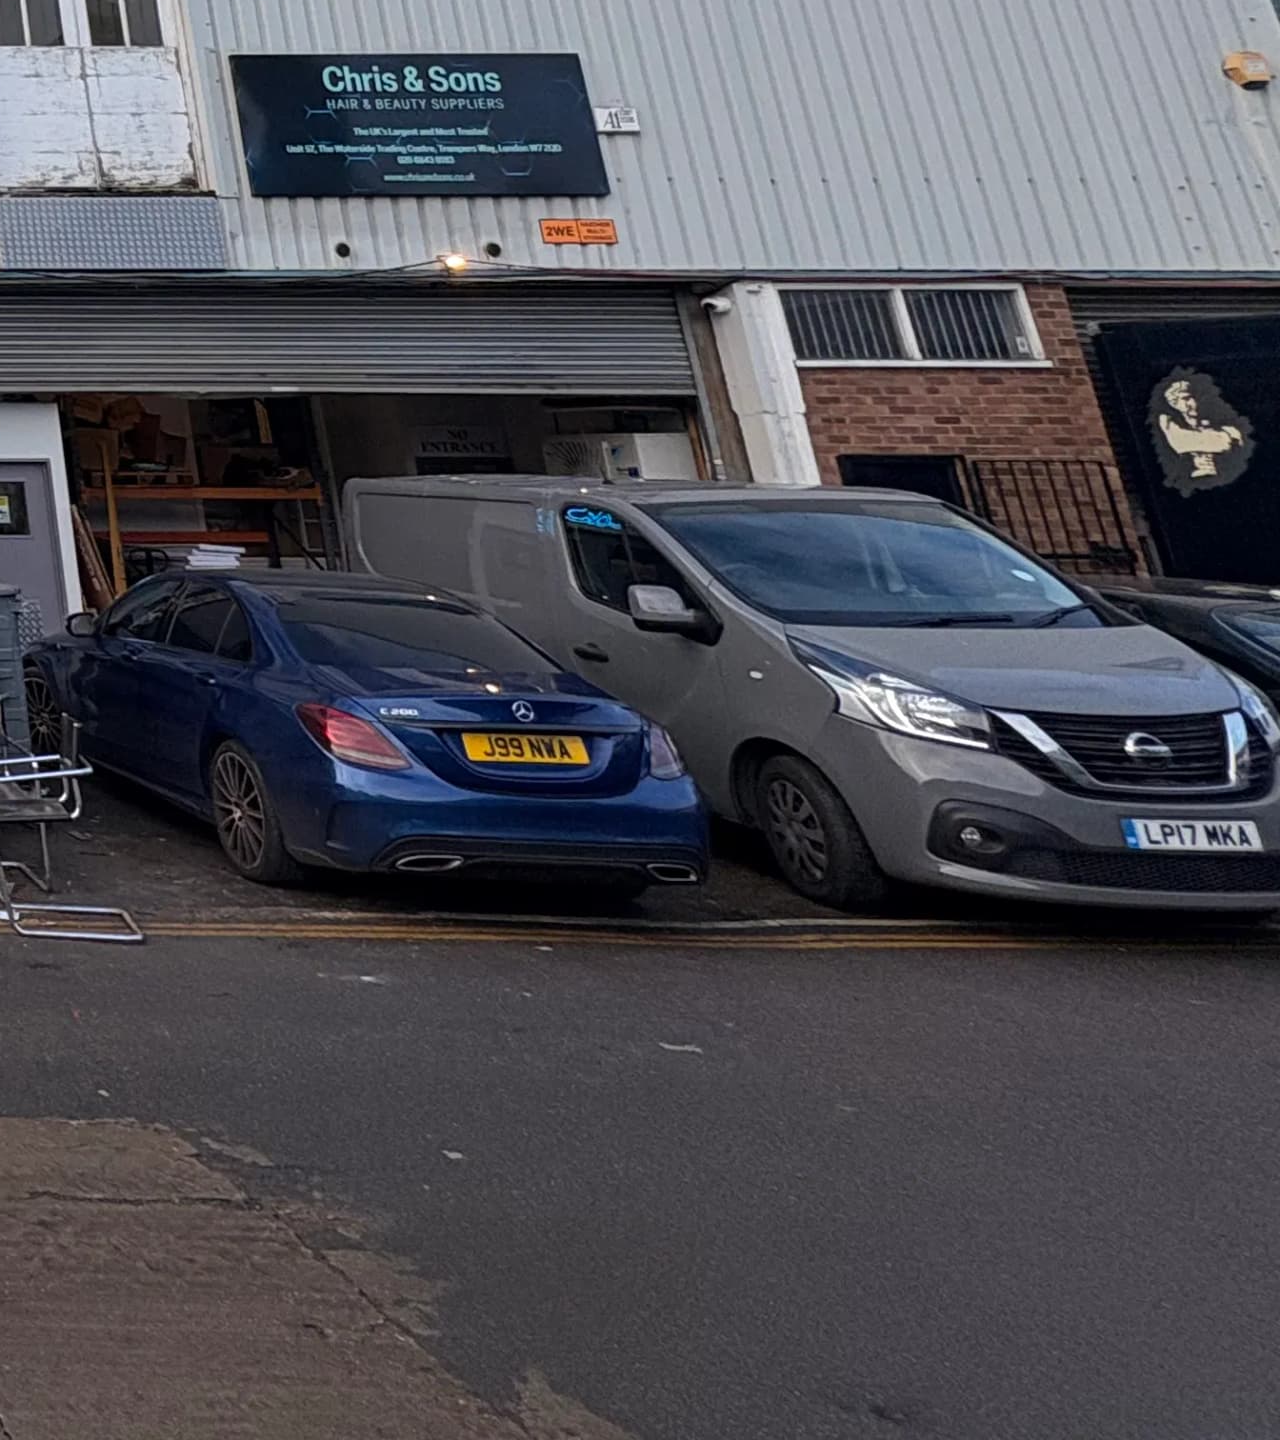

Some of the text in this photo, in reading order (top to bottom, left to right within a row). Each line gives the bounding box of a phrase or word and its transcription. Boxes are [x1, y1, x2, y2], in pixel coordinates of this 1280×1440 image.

[322, 65, 502, 92] Chris & Sons
[325, 97, 505, 110] HAIR & BEAUTY SUPPLIERS
[483, 735, 572, 760] J99 NWA
[1143, 823, 1253, 847] LP17 MKA
